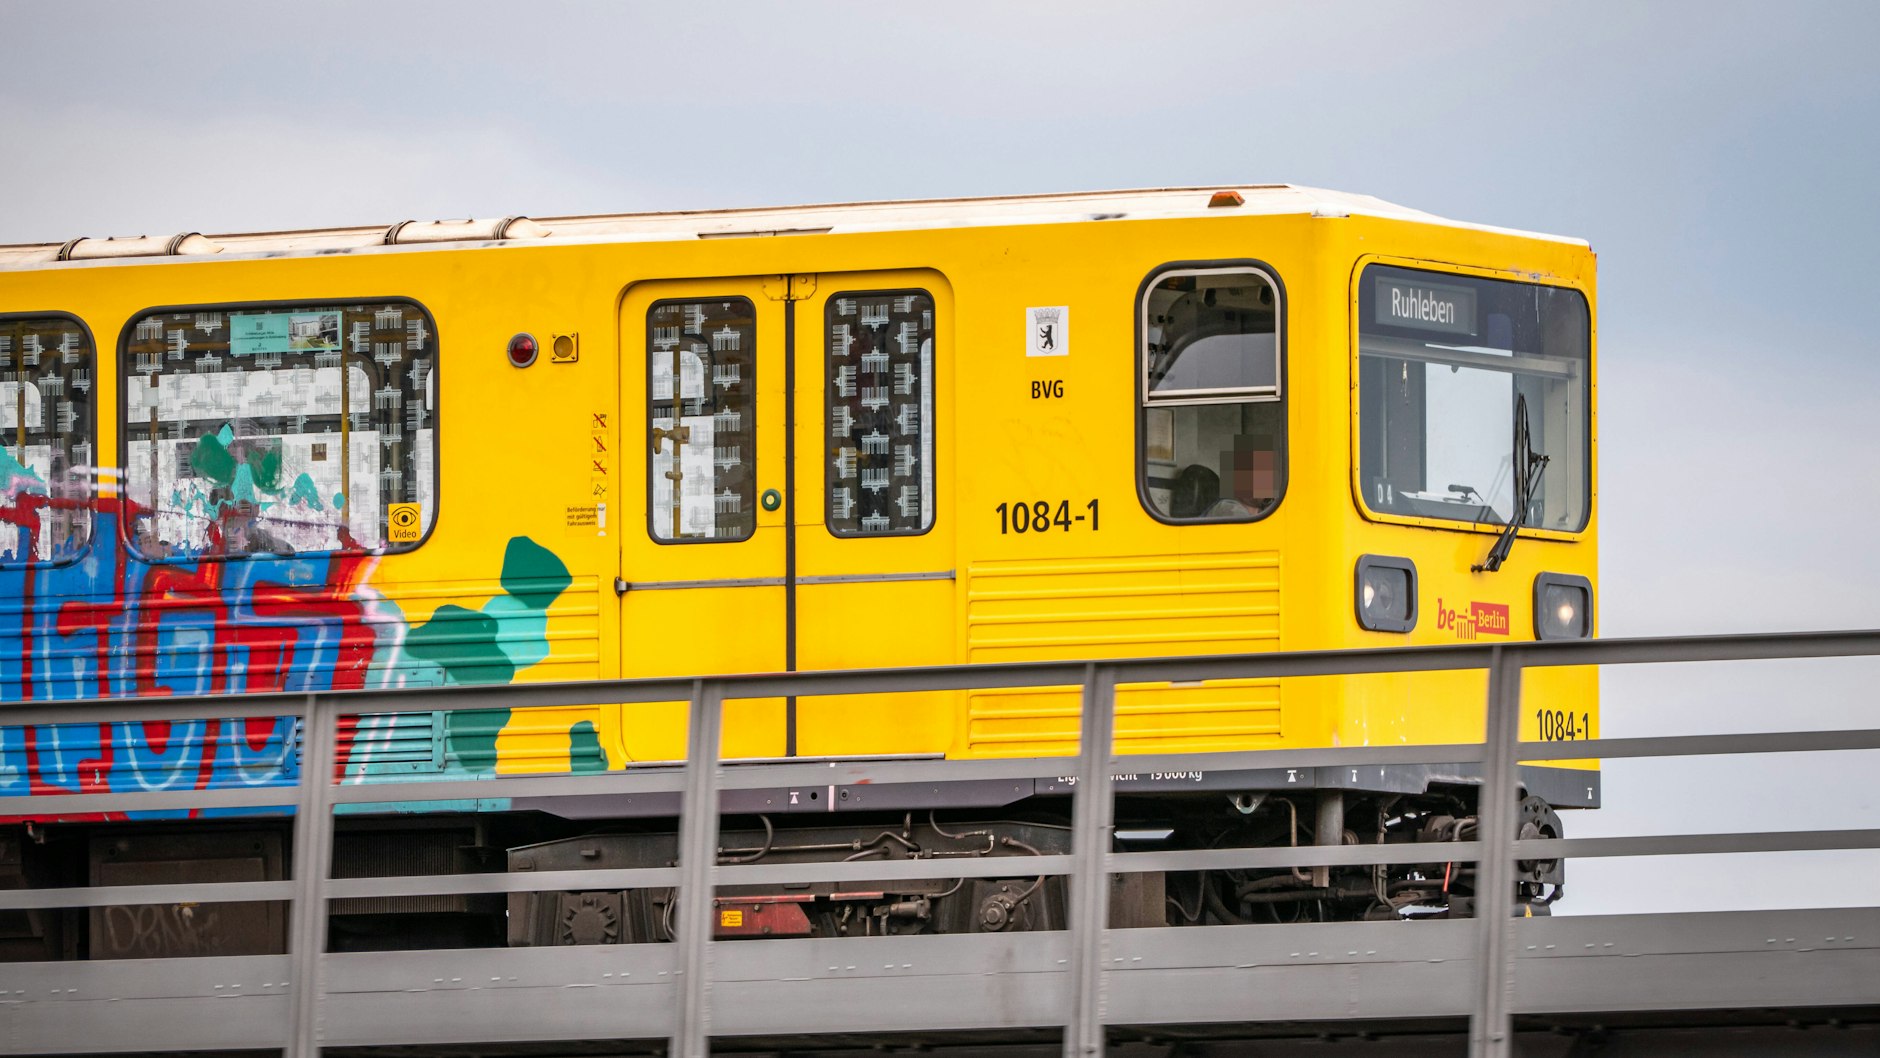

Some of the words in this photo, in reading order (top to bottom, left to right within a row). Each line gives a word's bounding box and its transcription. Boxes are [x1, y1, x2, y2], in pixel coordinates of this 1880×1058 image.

[1392, 287, 1454, 324] Ruhleben
[1031, 379, 1064, 399] BVG
[995, 498, 1099, 535] 1084-1
[393, 529, 417, 539] Video
[1437, 597, 1456, 631] be
[1477, 609, 1506, 630] Berlin
[1536, 708, 1589, 741] 1084-1
